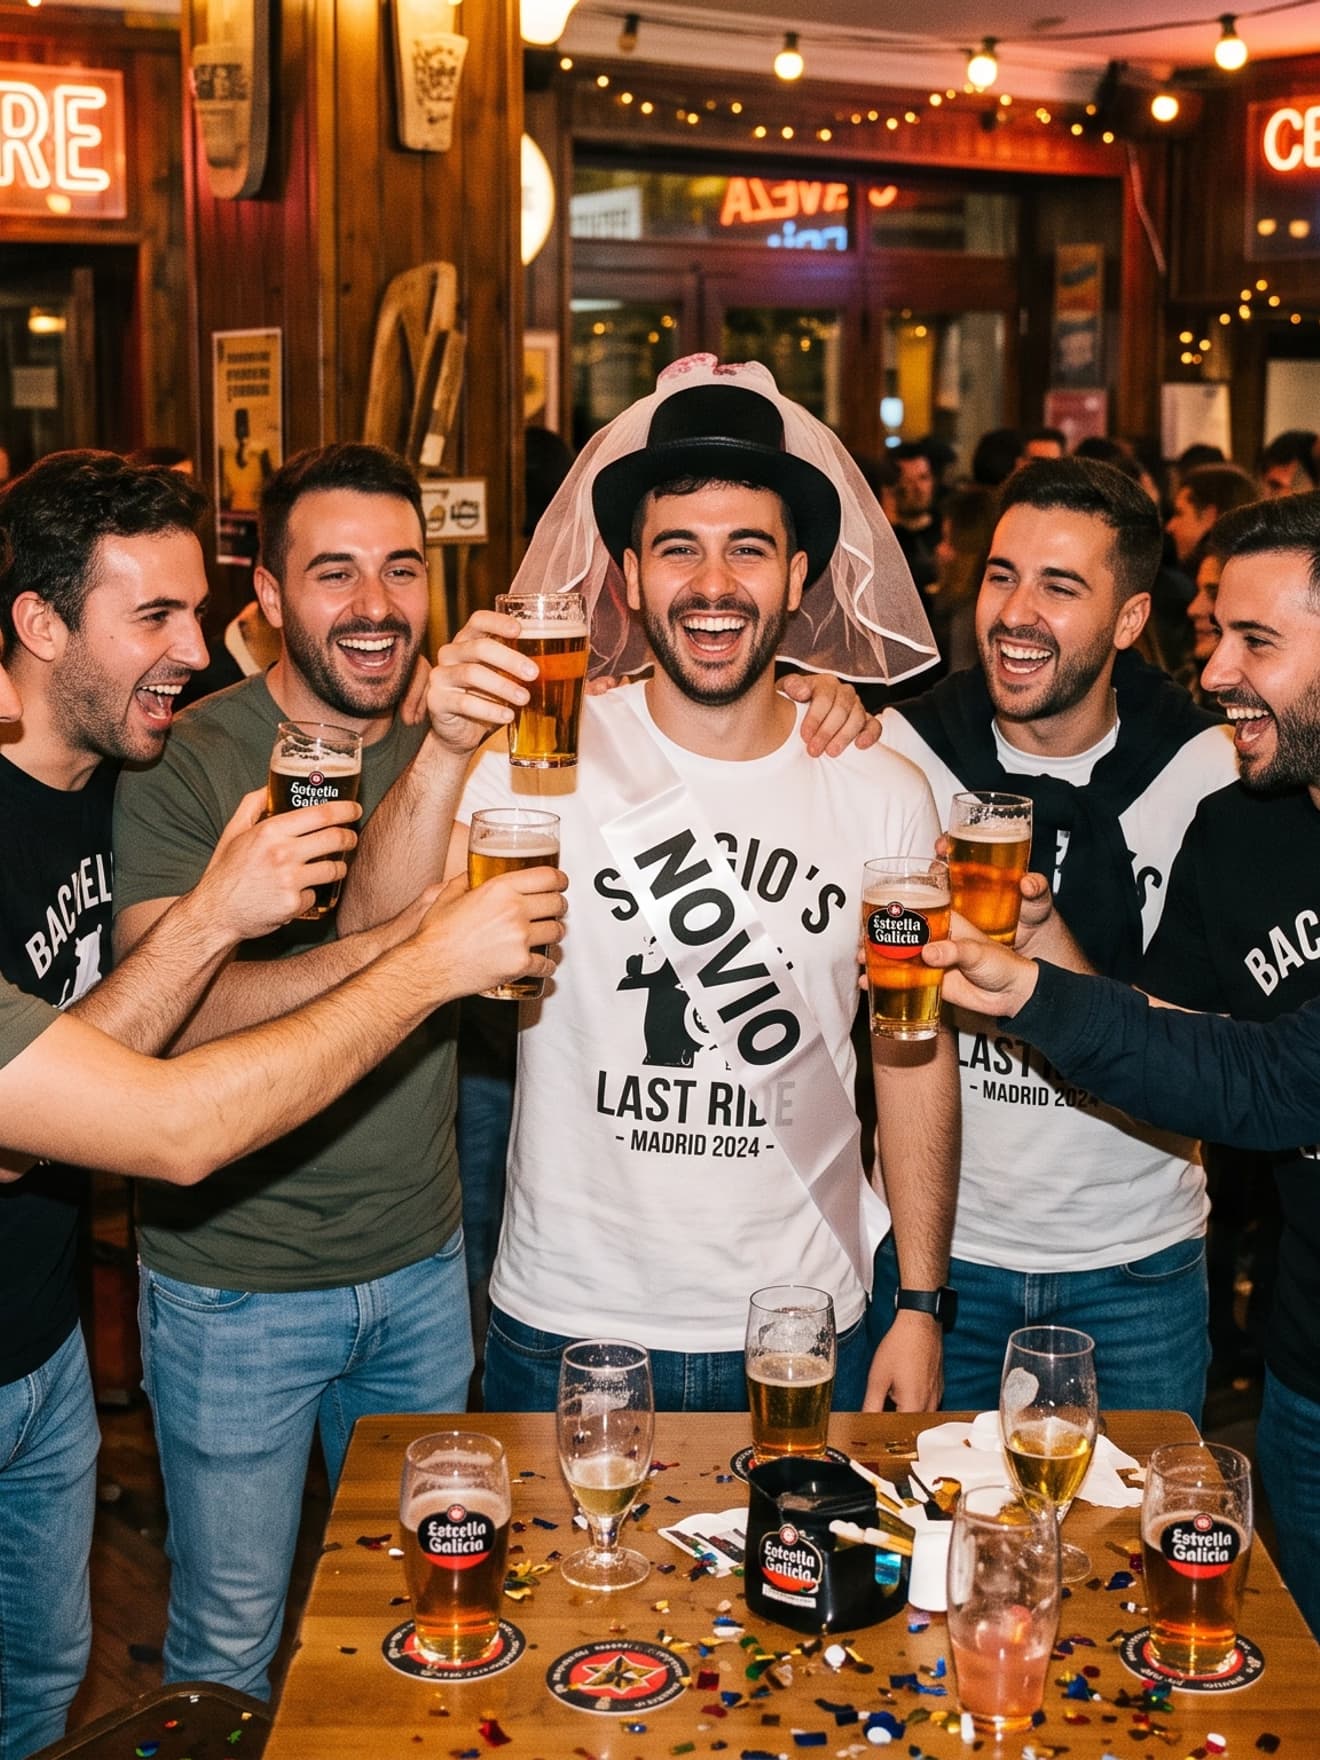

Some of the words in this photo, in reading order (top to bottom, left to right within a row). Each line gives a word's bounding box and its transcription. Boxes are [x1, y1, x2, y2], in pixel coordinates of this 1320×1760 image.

[0, 81, 110, 192] RE
[1263, 104, 1320, 171] CE
[633, 828, 801, 1066] NOVIO
[874, 928, 920, 944] Galicia
[1243, 909, 1320, 997] BAC
[596, 1070, 697, 1124] LAST
[983, 1079, 1050, 1107] MADRID
[630, 1128, 707, 1157] MADRID
[712, 1135, 761, 1159] 2024
[428, 1536, 484, 1554] Galicia
[1171, 1528, 1232, 1547] Estrella
[1173, 1543, 1229, 1563] Galicia
